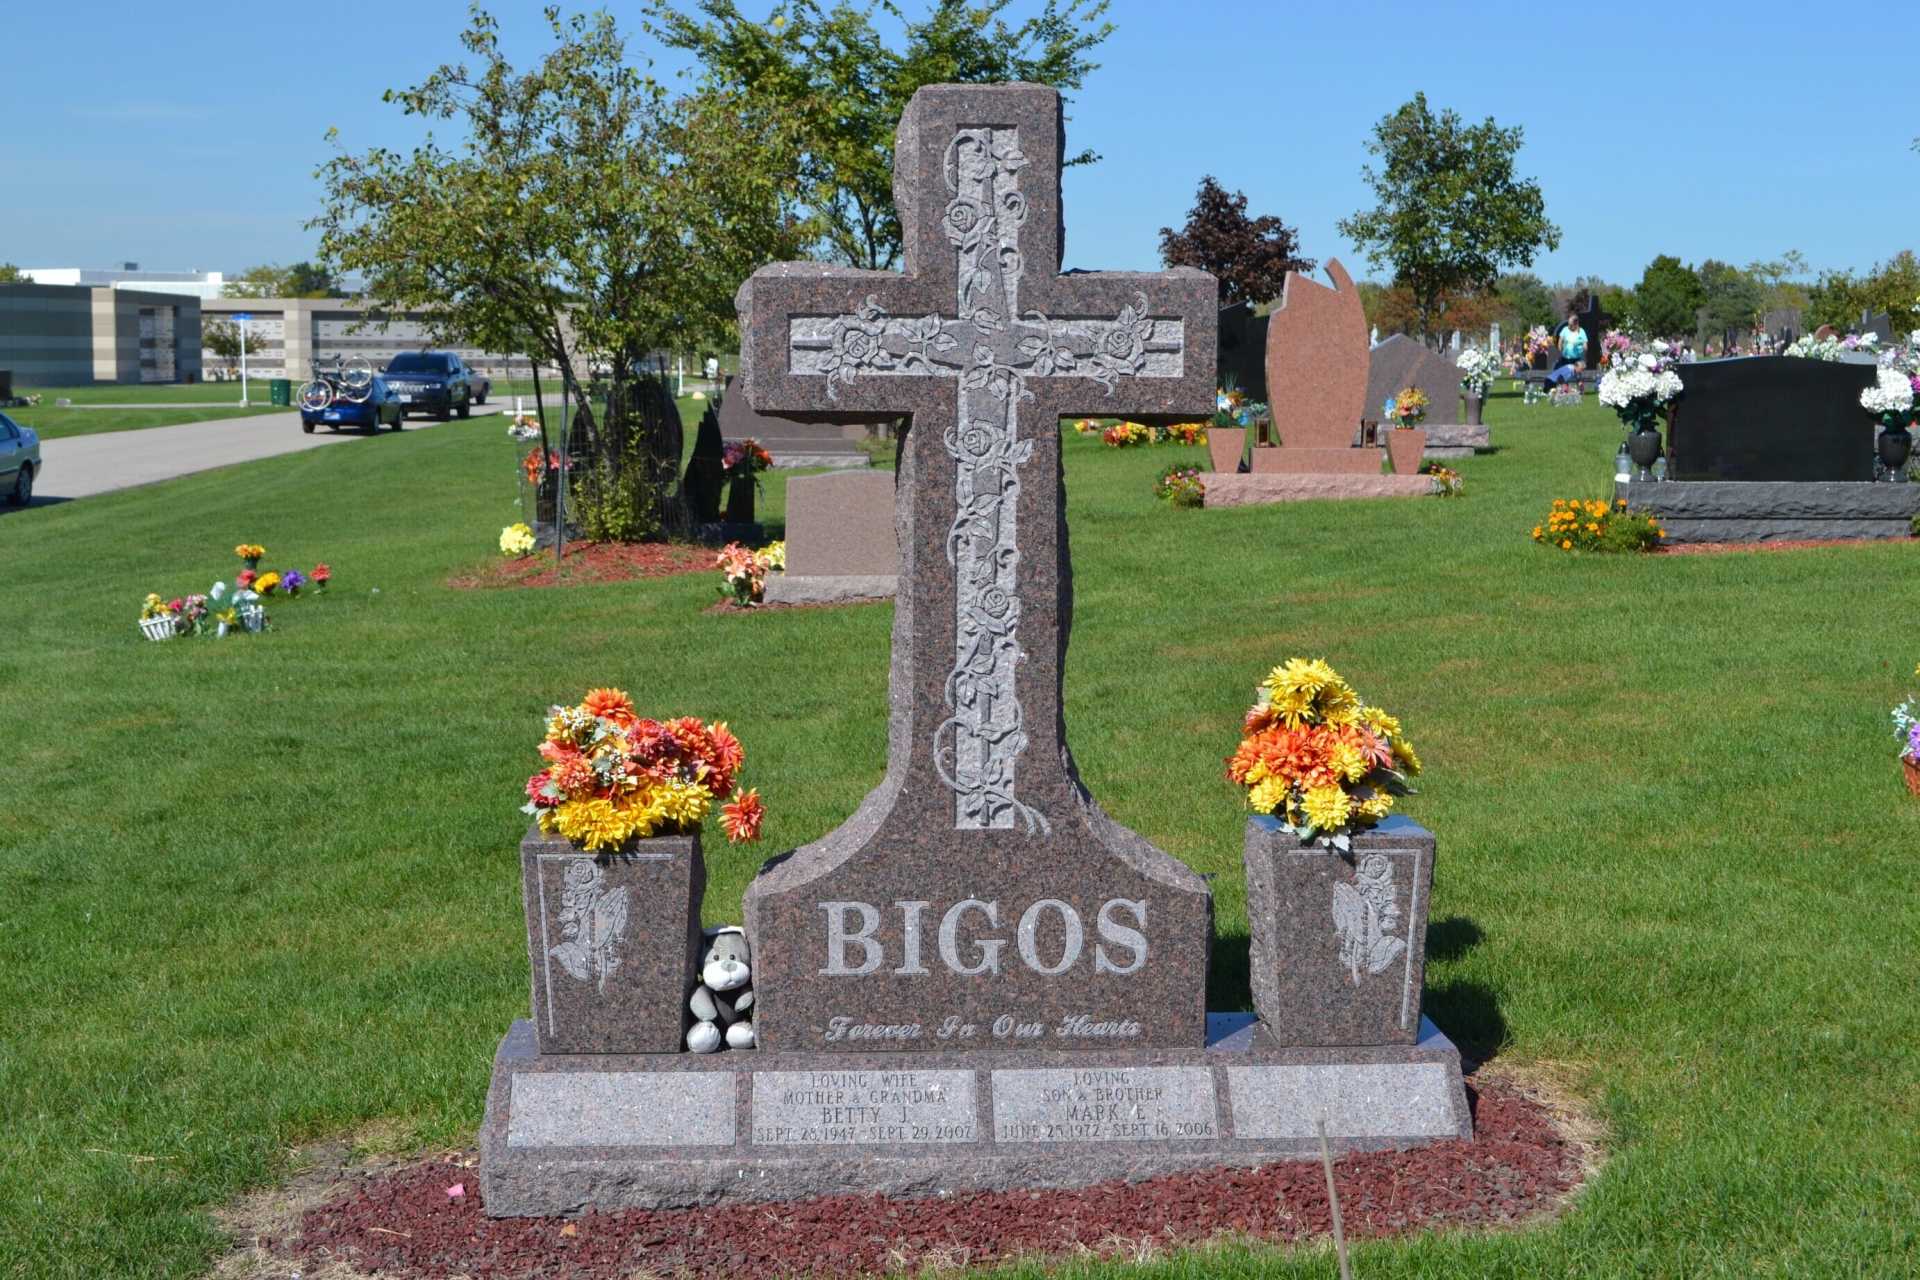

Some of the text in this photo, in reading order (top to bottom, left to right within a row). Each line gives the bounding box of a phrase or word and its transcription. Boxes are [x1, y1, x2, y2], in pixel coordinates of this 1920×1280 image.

[817, 897, 1148, 977] BIGOS
[824, 1013, 1142, 1041] Forever In Our Hearts
[811, 1073, 918, 1088] LOVING WIFE
[1073, 1071, 1130, 1086] LOVING
[783, 1090, 946, 1105] MOTHER & GRANDMA
[1042, 1087, 1163, 1102] SON & BROTHER
[823, 1106, 881, 1124] BETTY
[1065, 1104, 1119, 1121] MARK
[935, 1125, 972, 1139] 2007
[1003, 1124, 1039, 1139] JUNE
[1069, 1123, 1101, 1137] 1972
[1176, 1121, 1213, 1136] 2006
